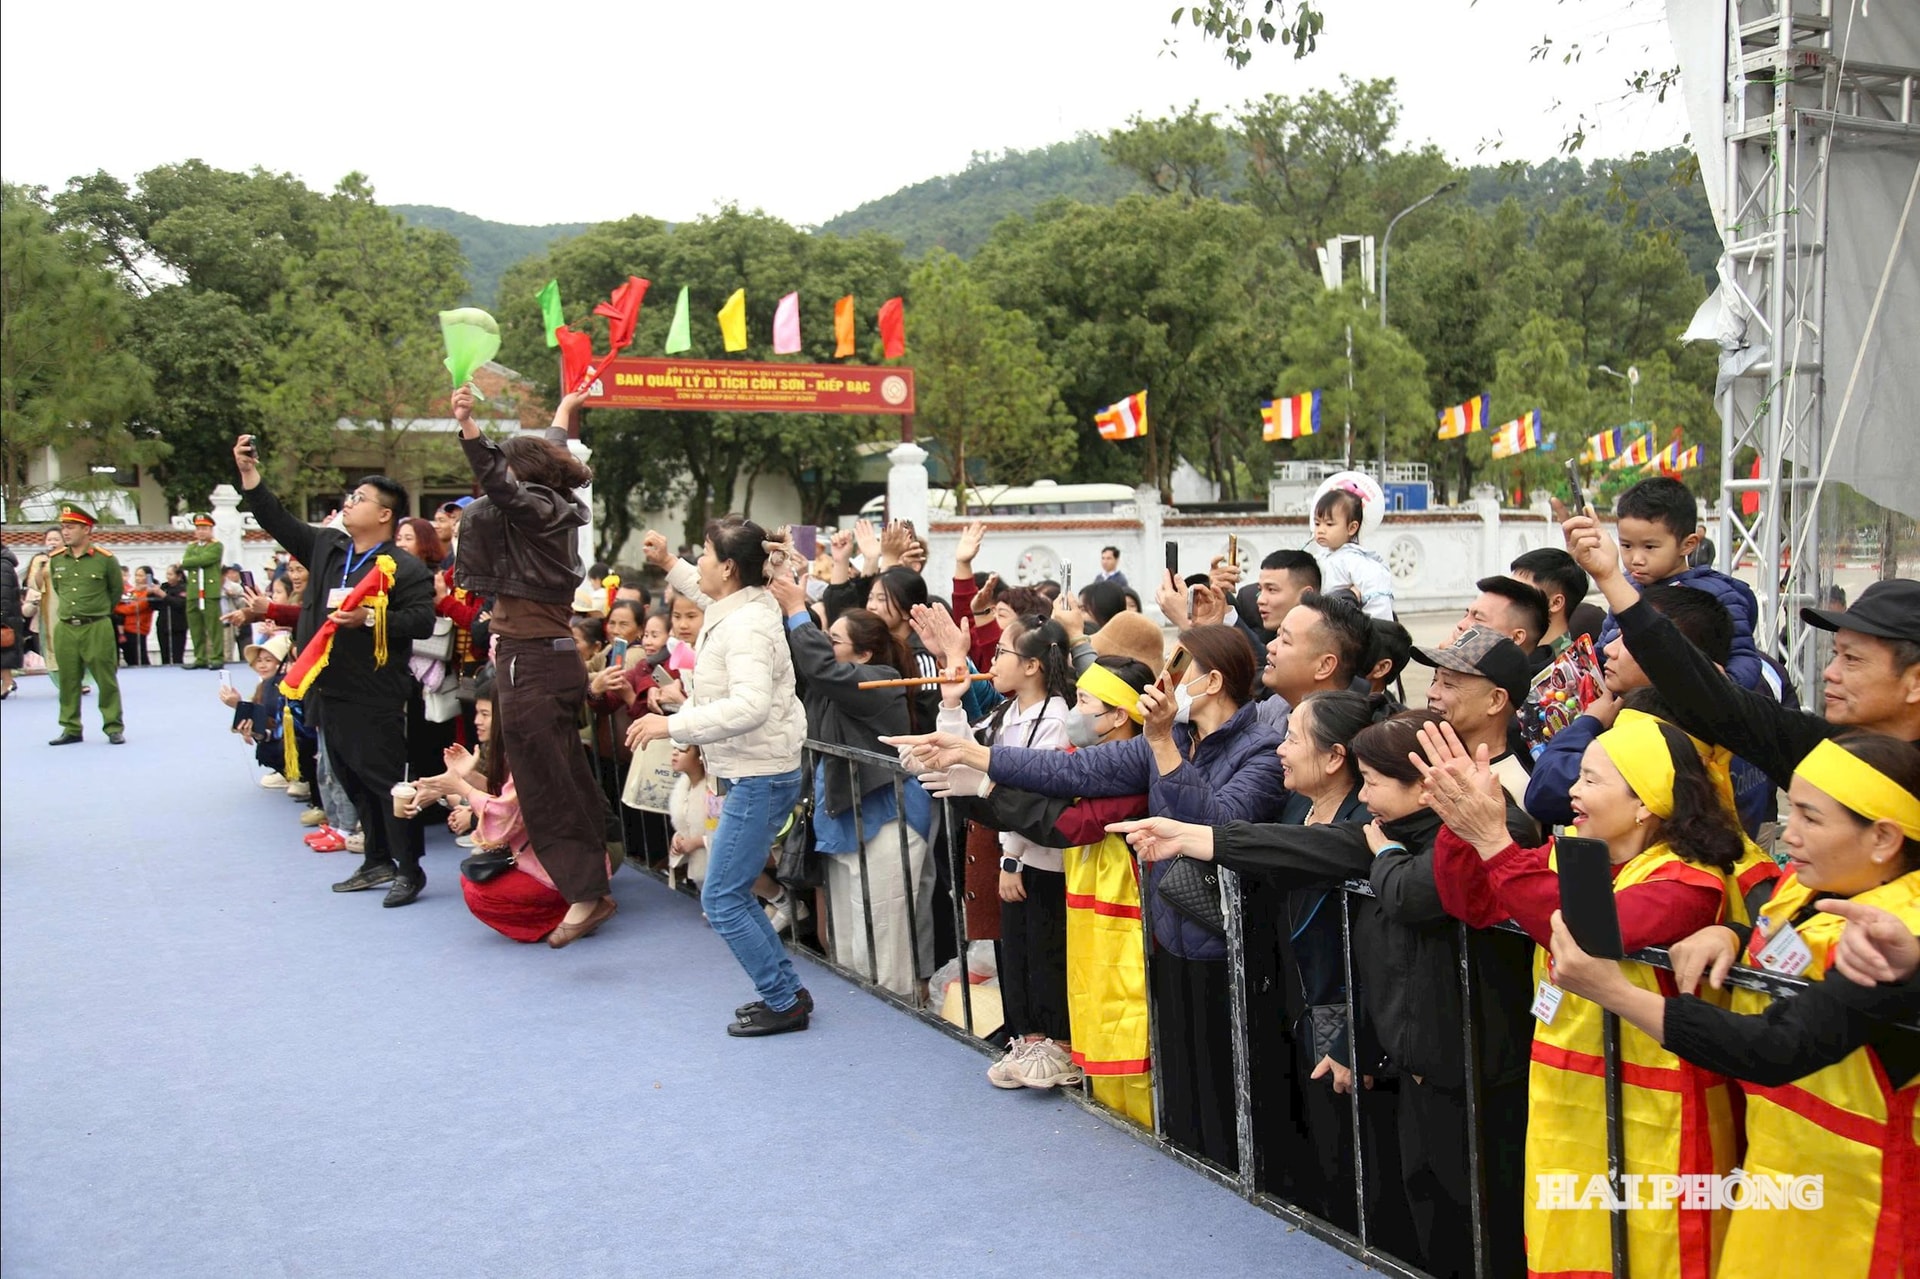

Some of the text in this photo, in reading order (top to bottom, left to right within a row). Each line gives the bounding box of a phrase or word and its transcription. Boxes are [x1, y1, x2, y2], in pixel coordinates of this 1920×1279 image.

[615, 373, 644, 387] BAN
[646, 371, 683, 388] QUẢN
[685, 374, 701, 388] LÝ
[703, 377, 718, 389] DI
[720, 375, 749, 390] TÍCH
[751, 376, 777, 390] CÔN
[779, 377, 806, 391] SƠN
[816, 376, 844, 392] KIẾP
[846, 381, 871, 395] BẠC
